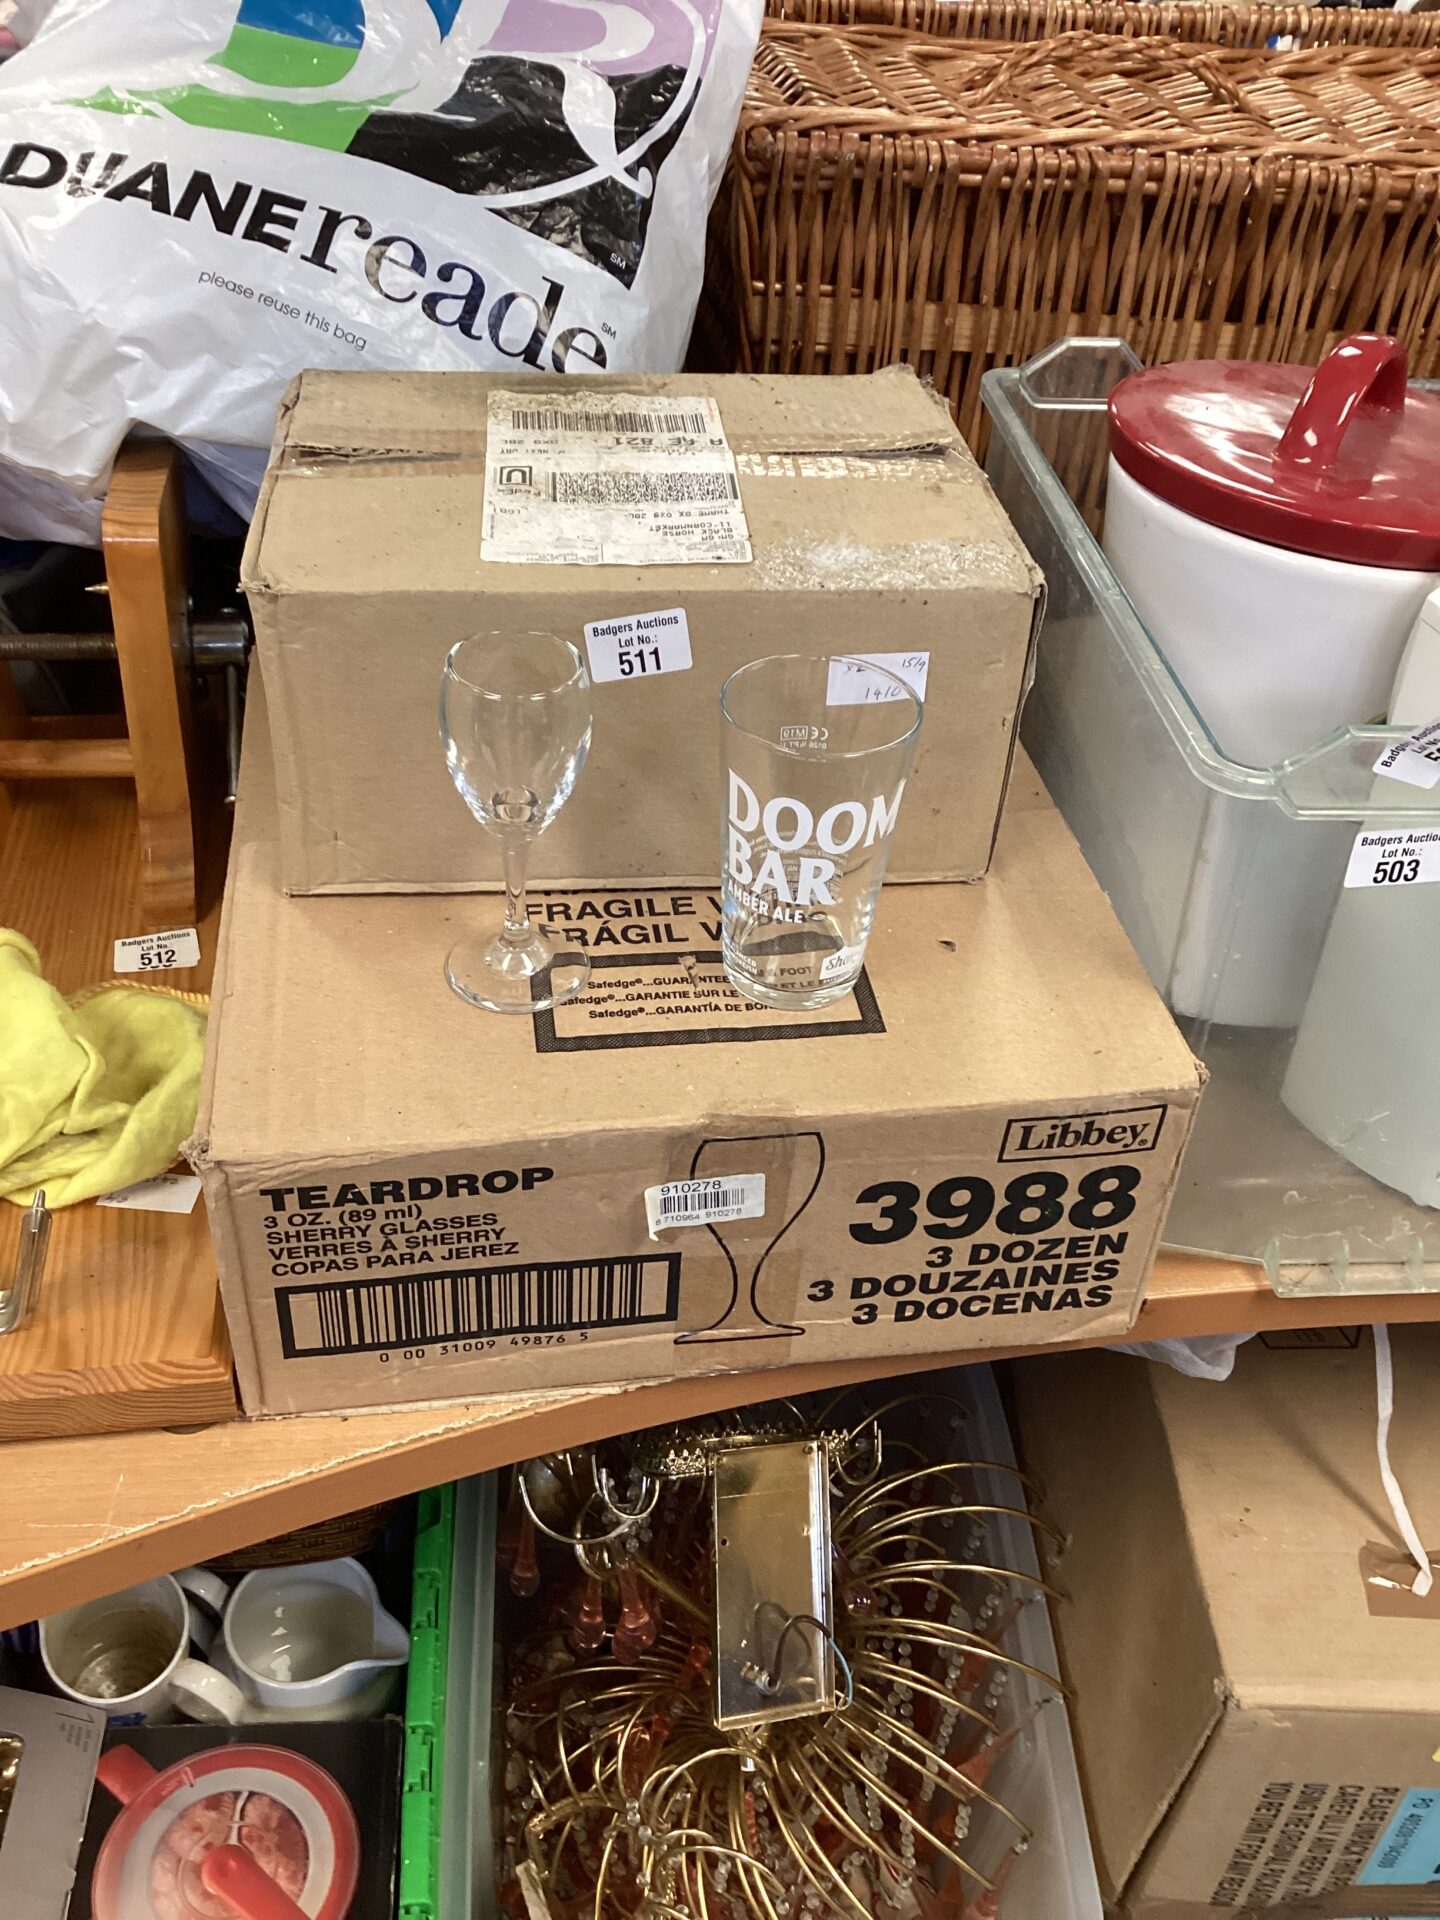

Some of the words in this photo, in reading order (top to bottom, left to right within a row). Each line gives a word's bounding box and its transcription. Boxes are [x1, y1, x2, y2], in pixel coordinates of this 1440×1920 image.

[1, 142, 308, 252] DUANE
[300, 203, 609, 373] reade
[199, 270, 253, 300] please
[258, 290, 301, 320] reuse
[304, 310, 330, 333] this
[334, 322, 367, 351] bag
[593, 622, 633, 638] Badgers
[636, 614, 679, 632] Auctions
[618, 637, 635, 649] Lot
[618, 647, 662, 676] 511
[728, 767, 907, 854] DOOM
[1361, 834, 1403, 848] Badgers
[1406, 832, 1440, 844] Auctio
[1381, 848, 1398, 858] Lot
[728, 824, 837, 906] BAR
[1372, 859, 1420, 884] 503
[526, 896, 697, 922] FRAGILE
[728, 879, 769, 916] AMBER
[772, 906, 804, 923] ALE
[121, 937, 154, 947] Badgers
[156, 931, 190, 943] Auctions
[140, 949, 177, 966] 512
[723, 989, 739, 998] LE
[725, 1003, 742, 1012] DE
[260, 1167, 554, 1213] TEARDROP
[661, 1180, 722, 1196] 910278
[263, 1215, 281, 1230] 3
[289, 1210, 333, 1228] OZ.
[338, 1206, 377, 1226] (89
[384, 1203, 423, 1222] ml)
[664, 1213, 700, 1223] 710964
[705, 1208, 743, 1218] 910278
[848, 1165, 1142, 1245] 3988
[266, 1225, 371, 1245] SHERRY
[379, 1213, 498, 1236] GLASSES
[270, 1241, 373, 1261] VERRES
[379, 1233, 400, 1253] À
[404, 1227, 507, 1250] SHERRY
[271, 1256, 359, 1277] COPAS
[366, 1249, 435, 1269] PARA
[440, 1241, 519, 1262] JEREZ
[925, 1247, 952, 1268] 3
[968, 1232, 1129, 1267] DOZEN
[807, 1280, 834, 1301] 3
[850, 1259, 1120, 1299] DOUZAINES
[852, 1304, 878, 1325] 3
[893, 1285, 1114, 1323] DOCENAS
[379, 1351, 389, 1363] 0
[403, 1348, 426, 1360] 00
[439, 1339, 497, 1357] 31009
[509, 1334, 566, 1348] 49876
[579, 1331, 589, 1342] 5
